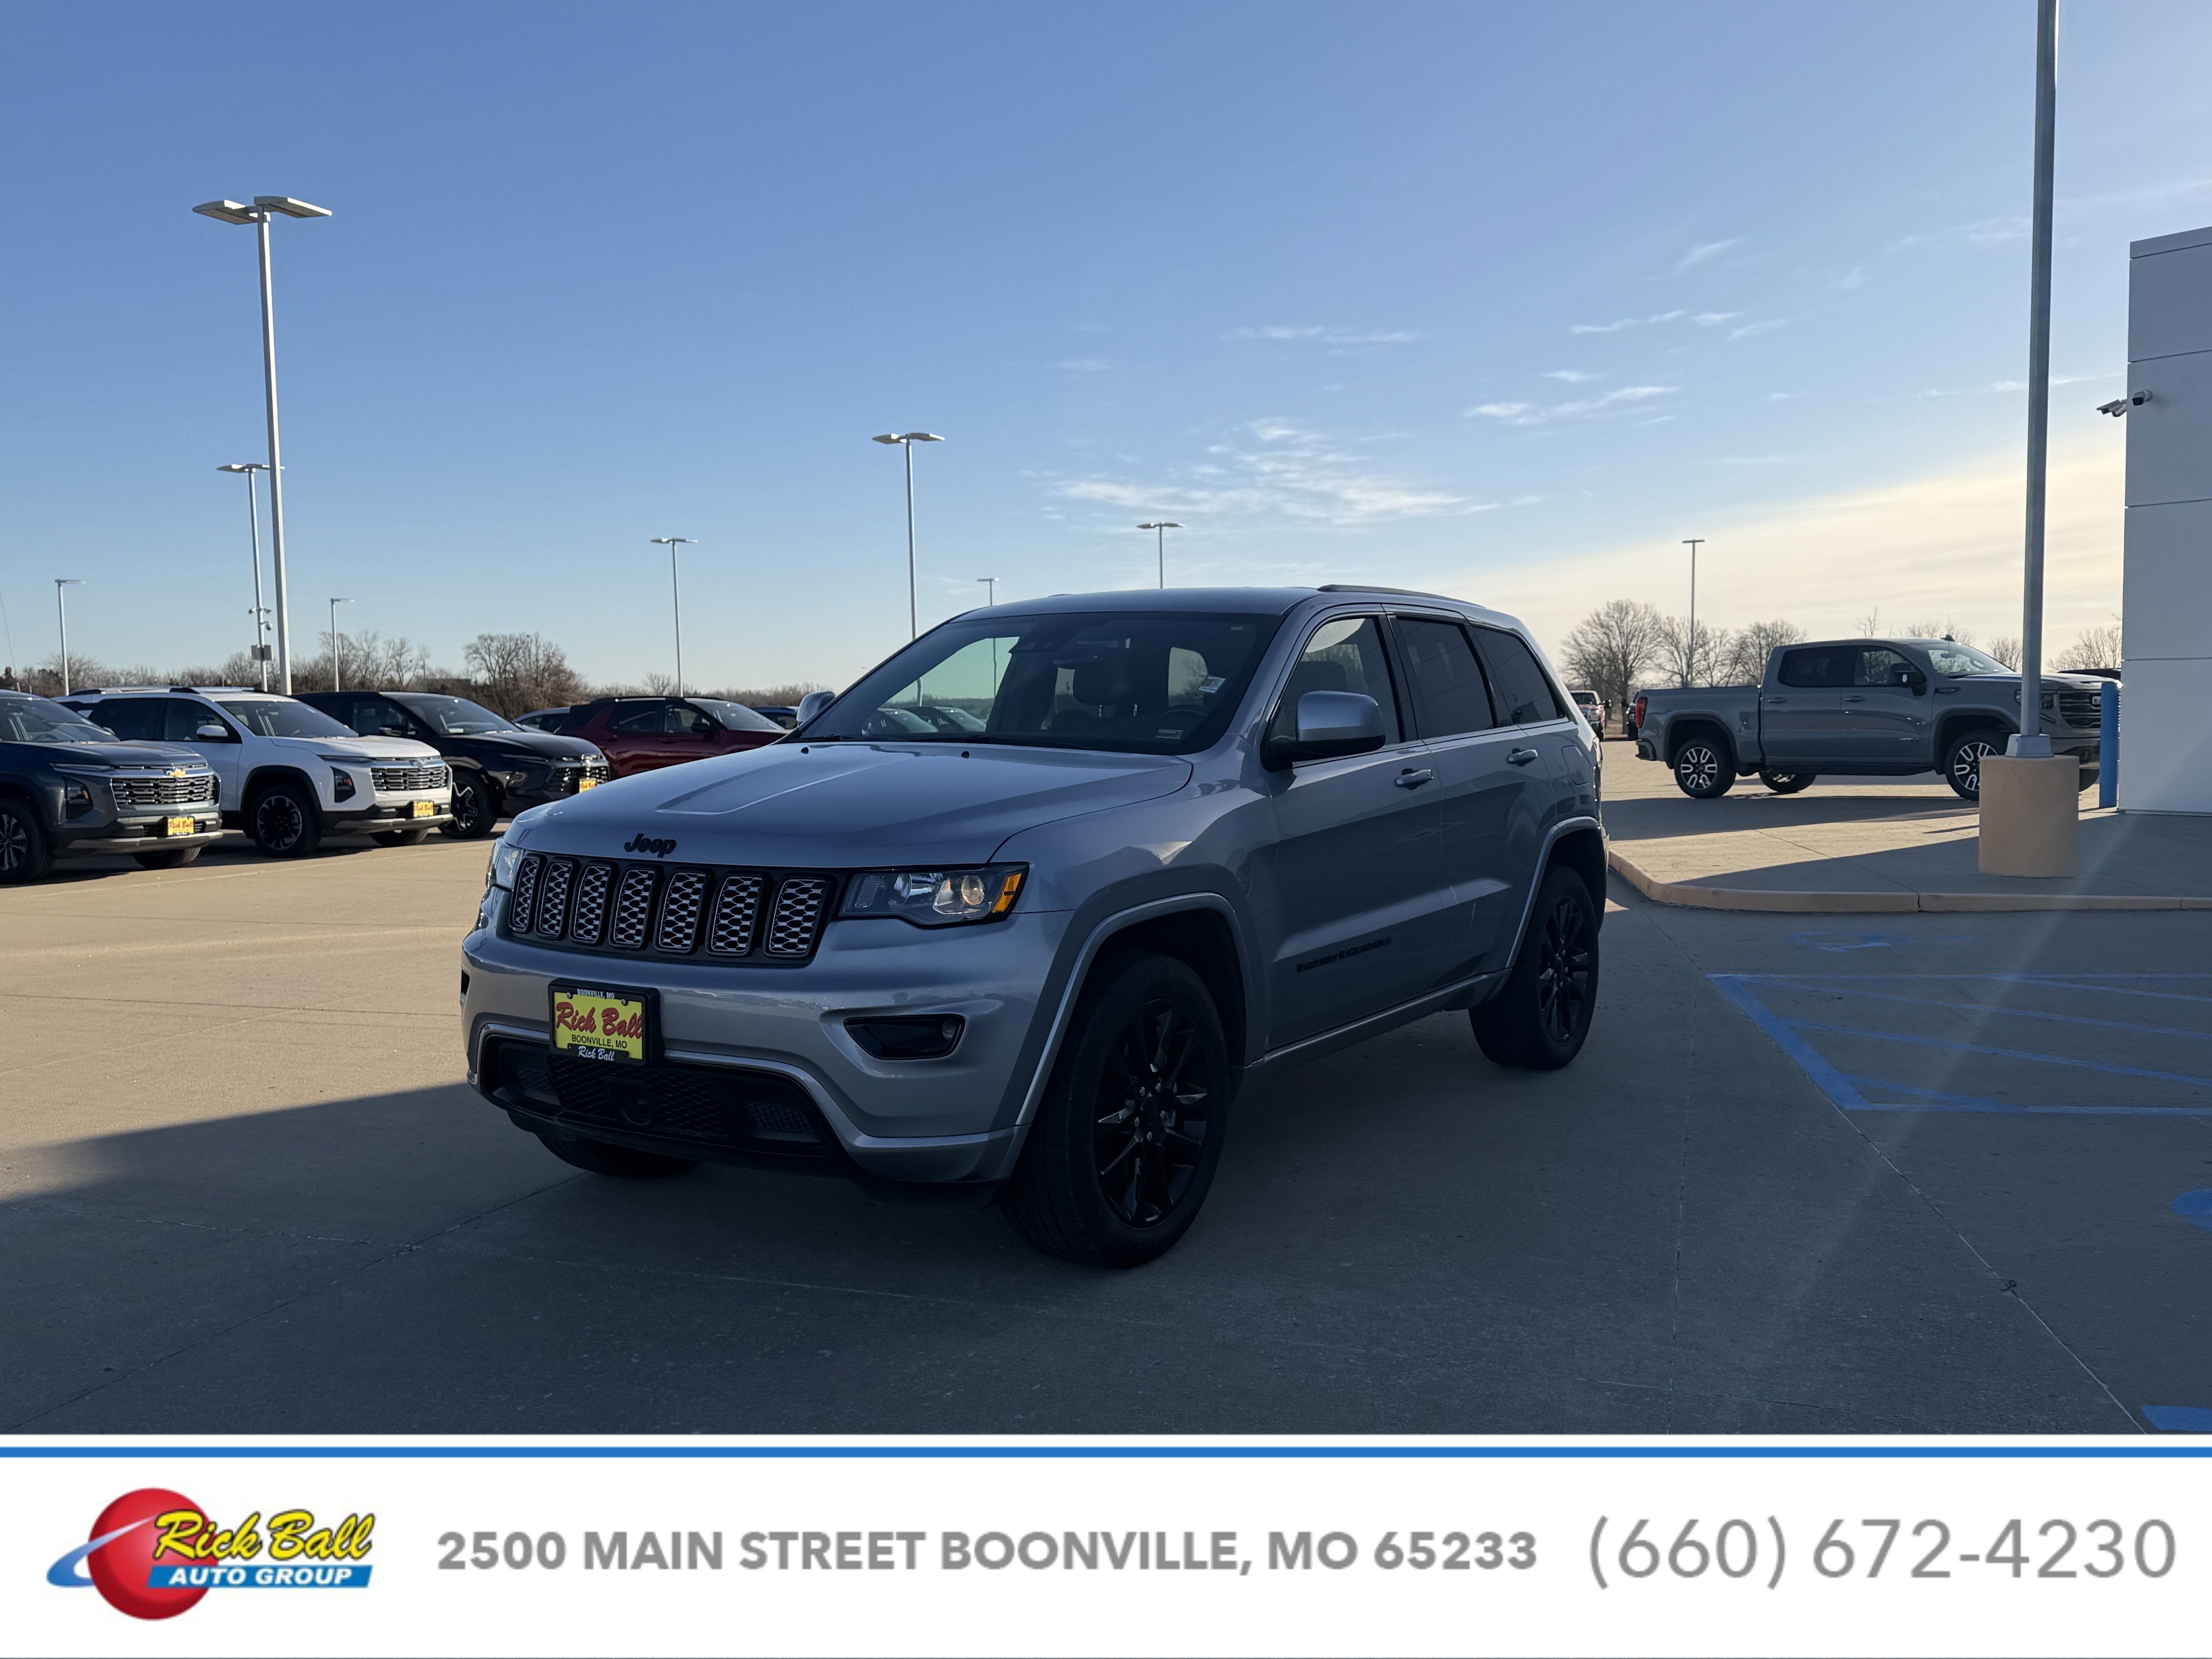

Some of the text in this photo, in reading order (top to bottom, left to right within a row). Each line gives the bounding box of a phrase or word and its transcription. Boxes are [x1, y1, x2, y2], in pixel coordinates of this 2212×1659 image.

[624, 833, 677, 858] Jeep
[556, 1001, 642, 1039] Rick Ball
[572, 1034, 627, 1049] BOONVILLE, MO
[578, 1045, 615, 1061] Rick Ball
